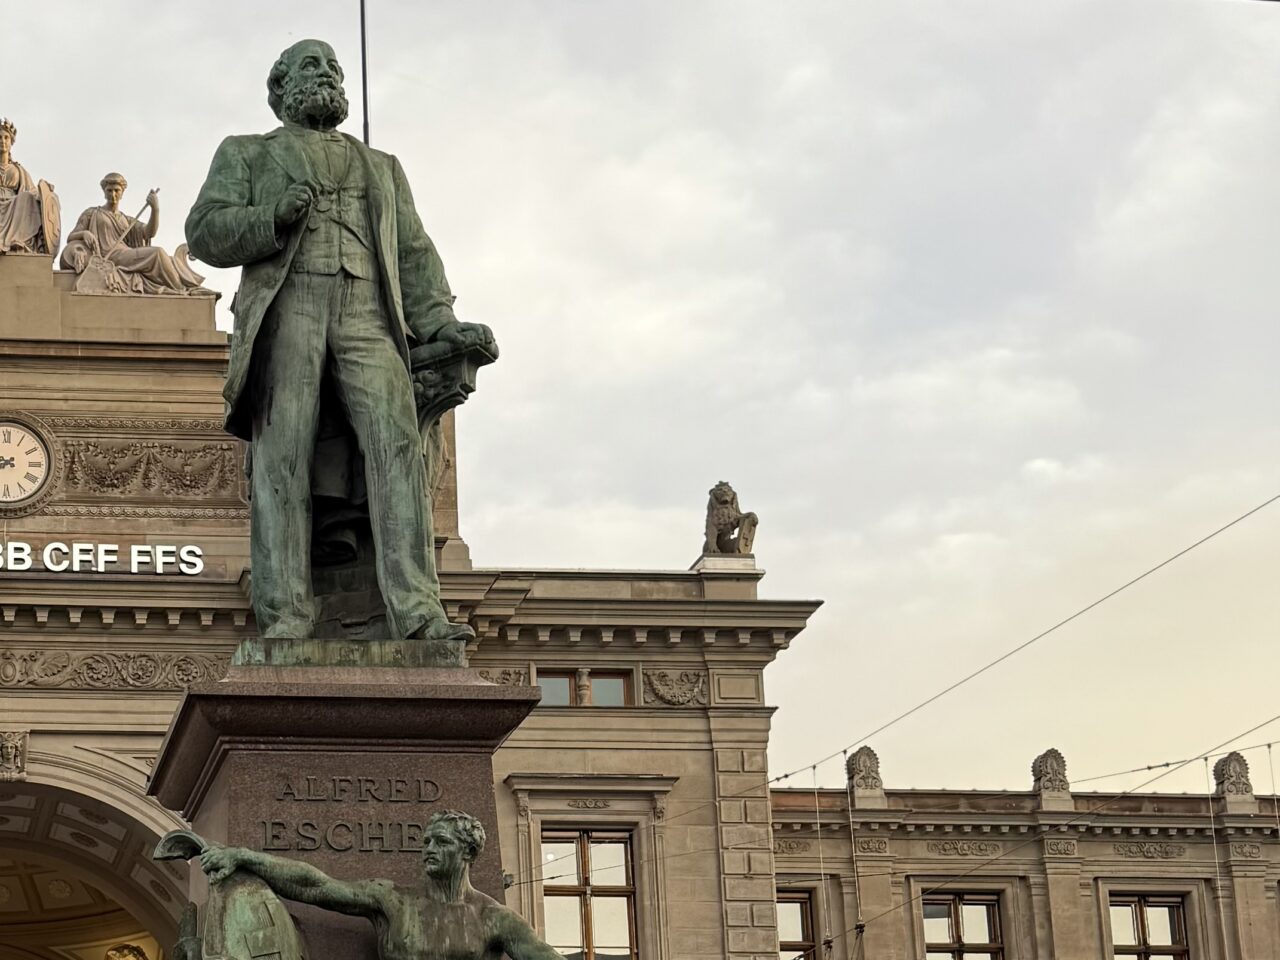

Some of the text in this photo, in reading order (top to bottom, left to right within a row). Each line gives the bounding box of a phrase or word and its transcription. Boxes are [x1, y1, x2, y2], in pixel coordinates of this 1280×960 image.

[42, 542, 119, 573] CFF
[130, 544, 205, 576] FFS
[276, 775, 444, 803] ALFRED
[261, 820, 424, 852] ESCHE
